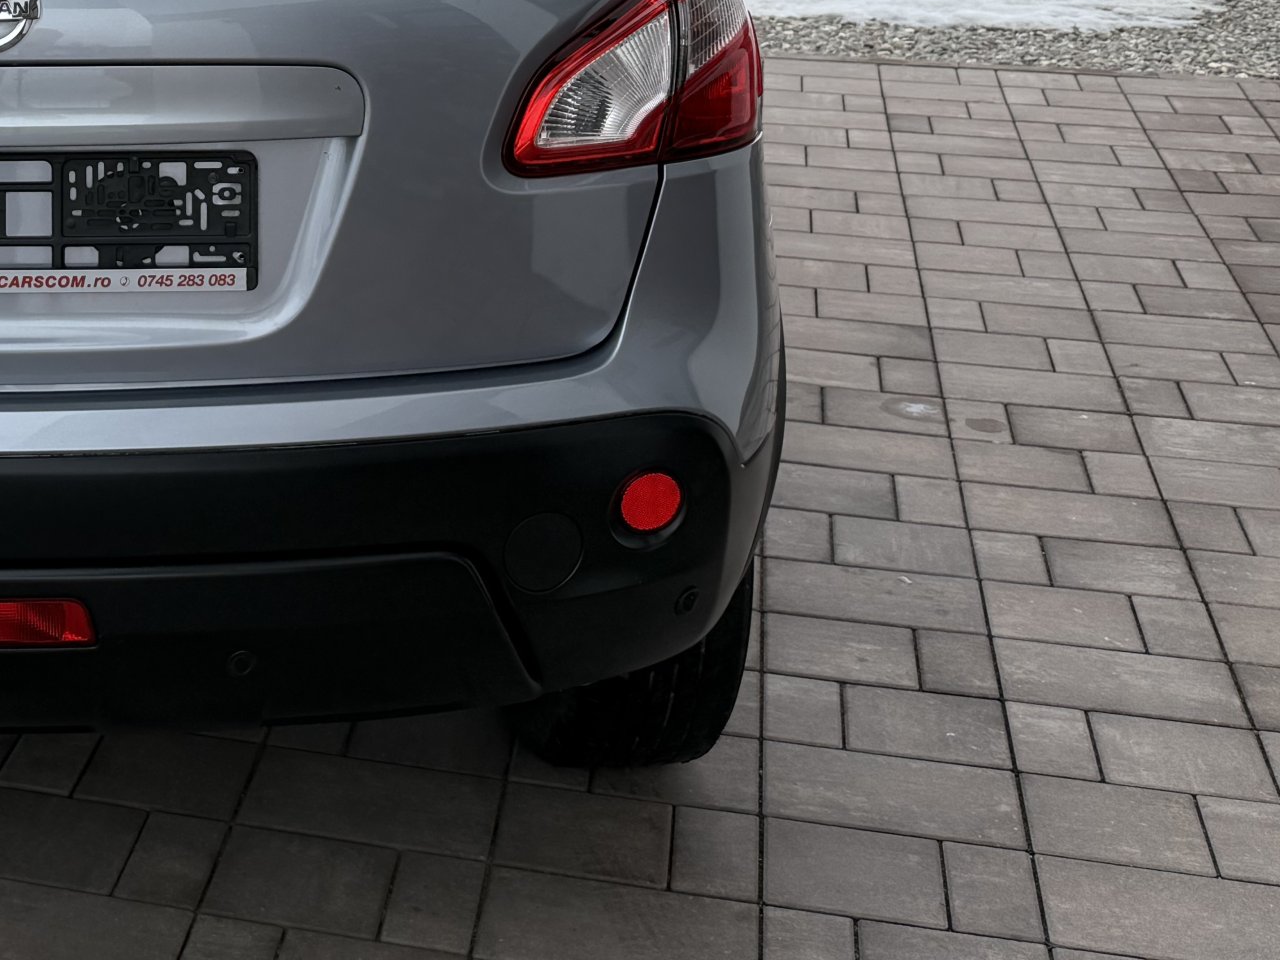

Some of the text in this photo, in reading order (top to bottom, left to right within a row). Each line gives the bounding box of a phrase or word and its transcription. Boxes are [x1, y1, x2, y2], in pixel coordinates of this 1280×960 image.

[137, 274, 174, 288] 0745
[177, 274, 205, 288] 283
[208, 273, 236, 287] 083
